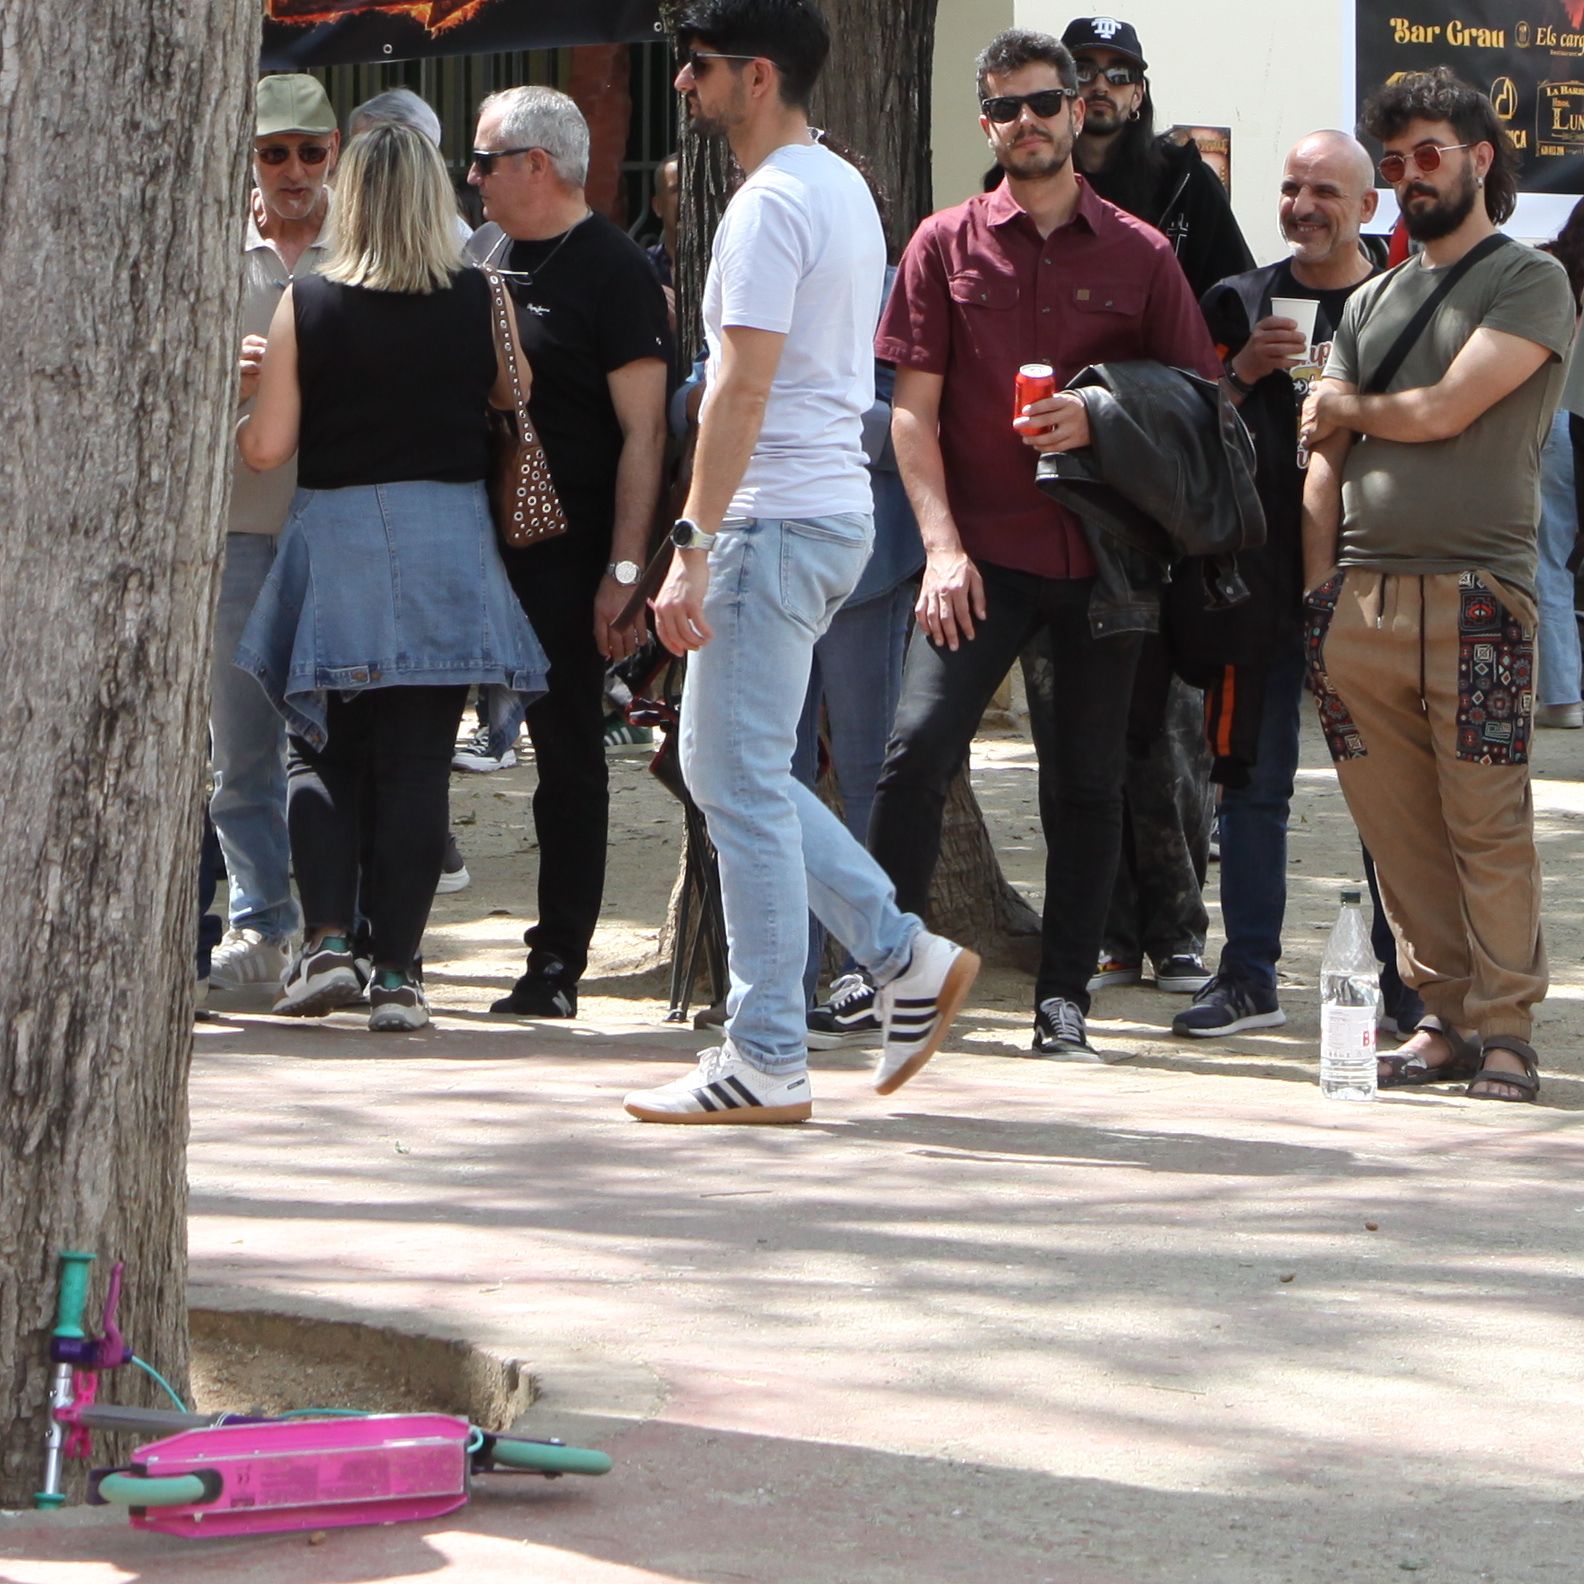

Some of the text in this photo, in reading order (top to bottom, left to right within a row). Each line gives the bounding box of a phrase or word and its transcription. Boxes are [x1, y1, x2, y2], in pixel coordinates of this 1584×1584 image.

[1389, 17, 1505, 49] Bar Grau
[1536, 25, 1557, 47] Els
